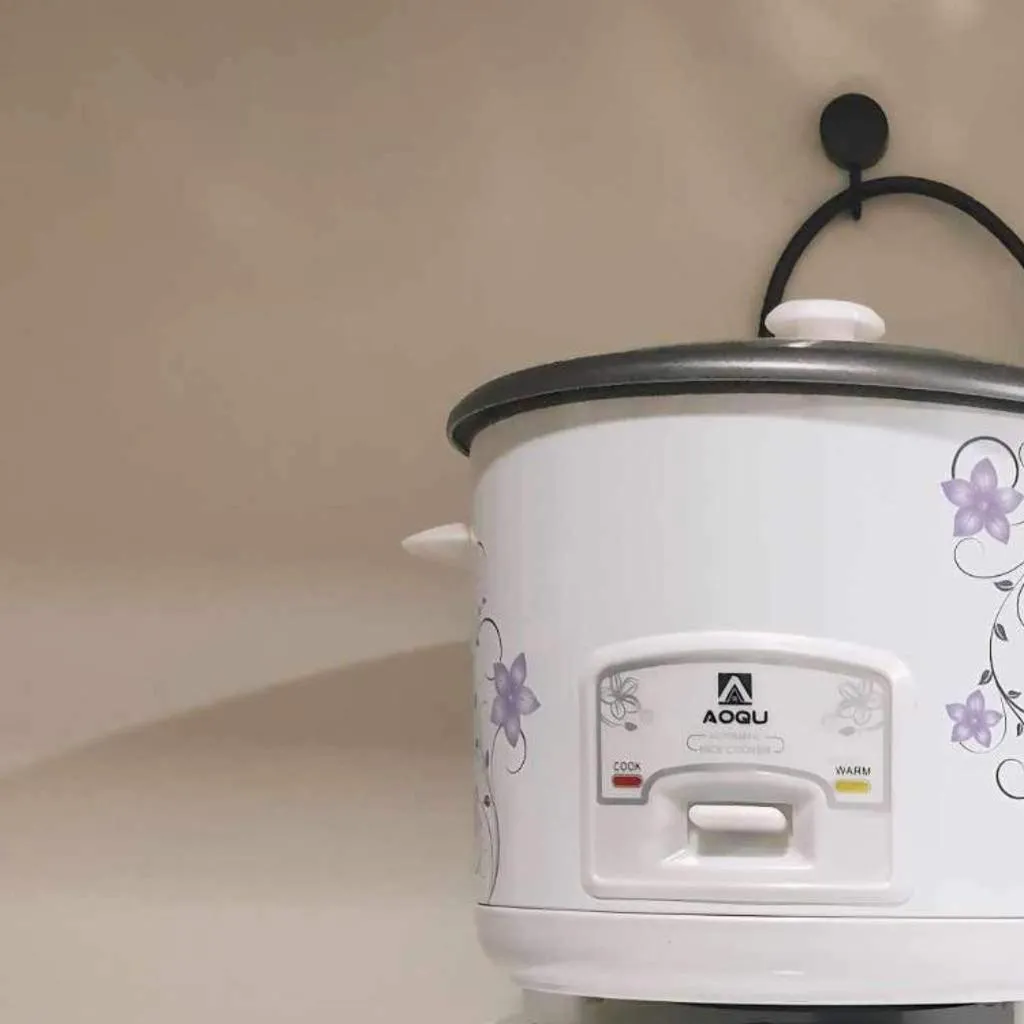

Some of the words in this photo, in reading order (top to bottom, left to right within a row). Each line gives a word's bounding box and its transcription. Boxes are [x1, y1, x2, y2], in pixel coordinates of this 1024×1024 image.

[703, 710, 768, 724] AOQU
[613, 762, 641, 772] COOK
[835, 766, 871, 776] WARM
